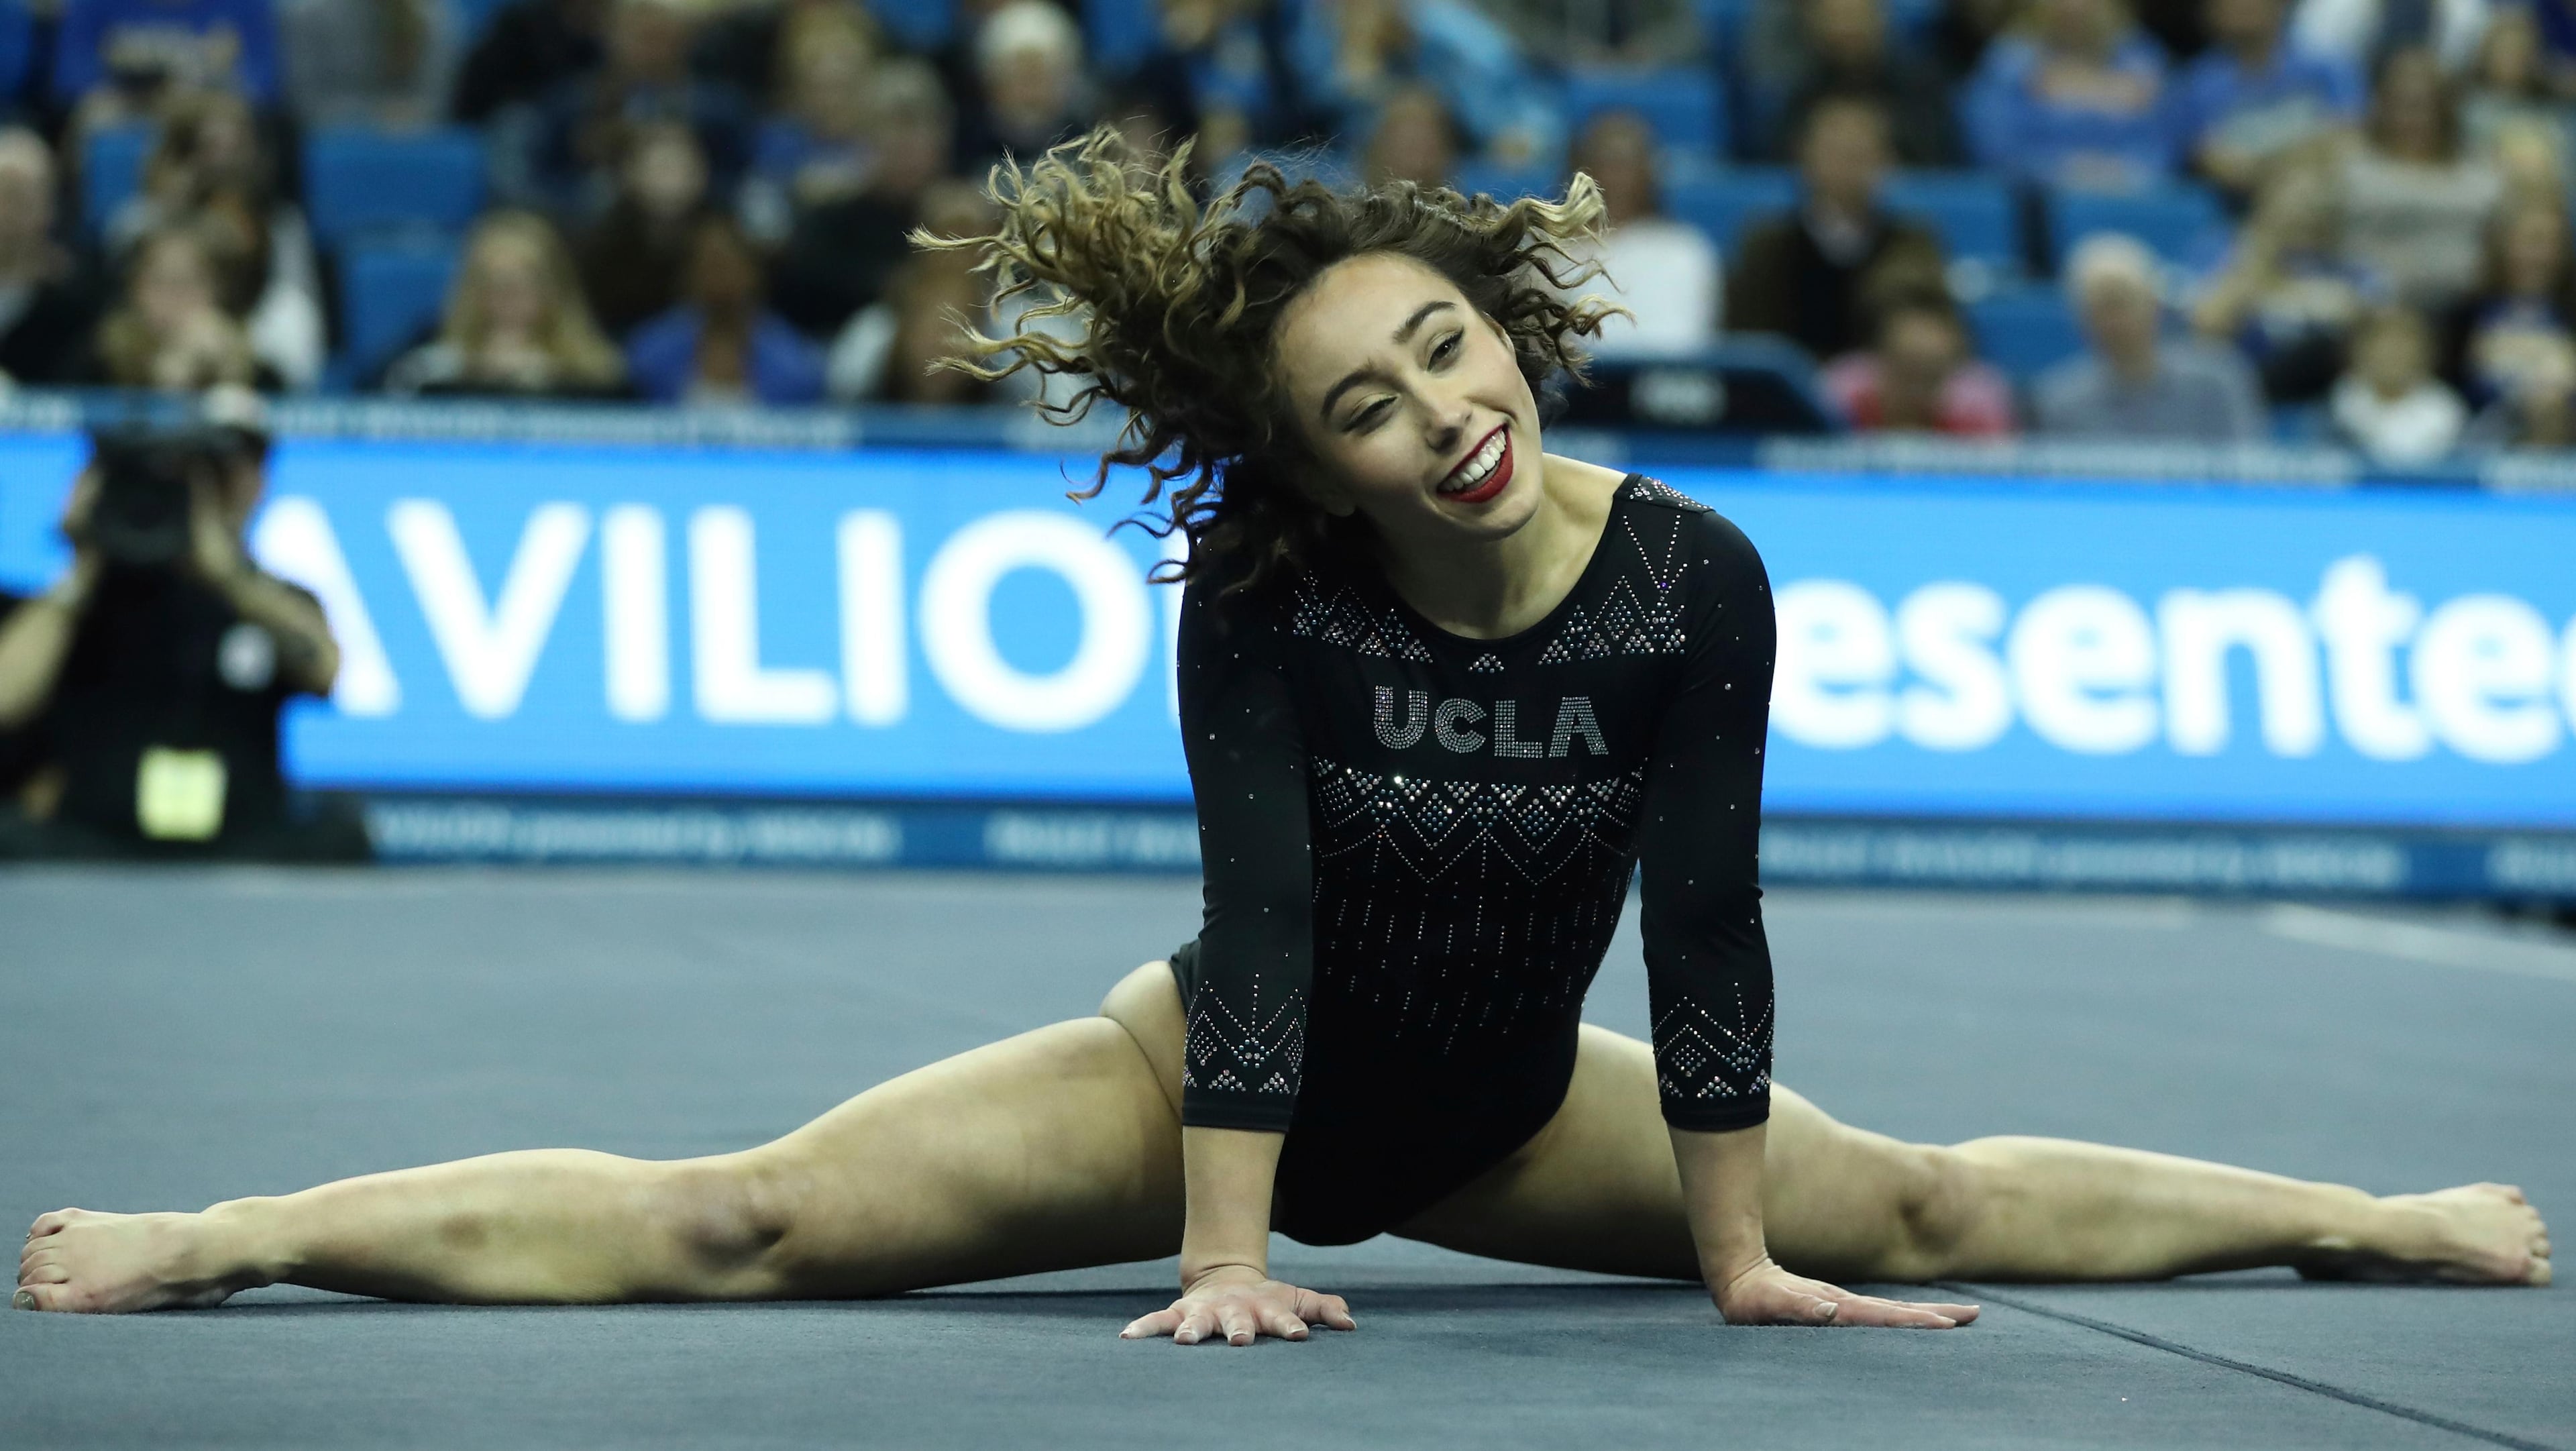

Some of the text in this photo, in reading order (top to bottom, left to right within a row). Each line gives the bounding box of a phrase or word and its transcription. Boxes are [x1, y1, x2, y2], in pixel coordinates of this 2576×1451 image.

[250, 496, 2576, 763] AVILIO esente
[1373, 684, 1609, 759] UCLA
